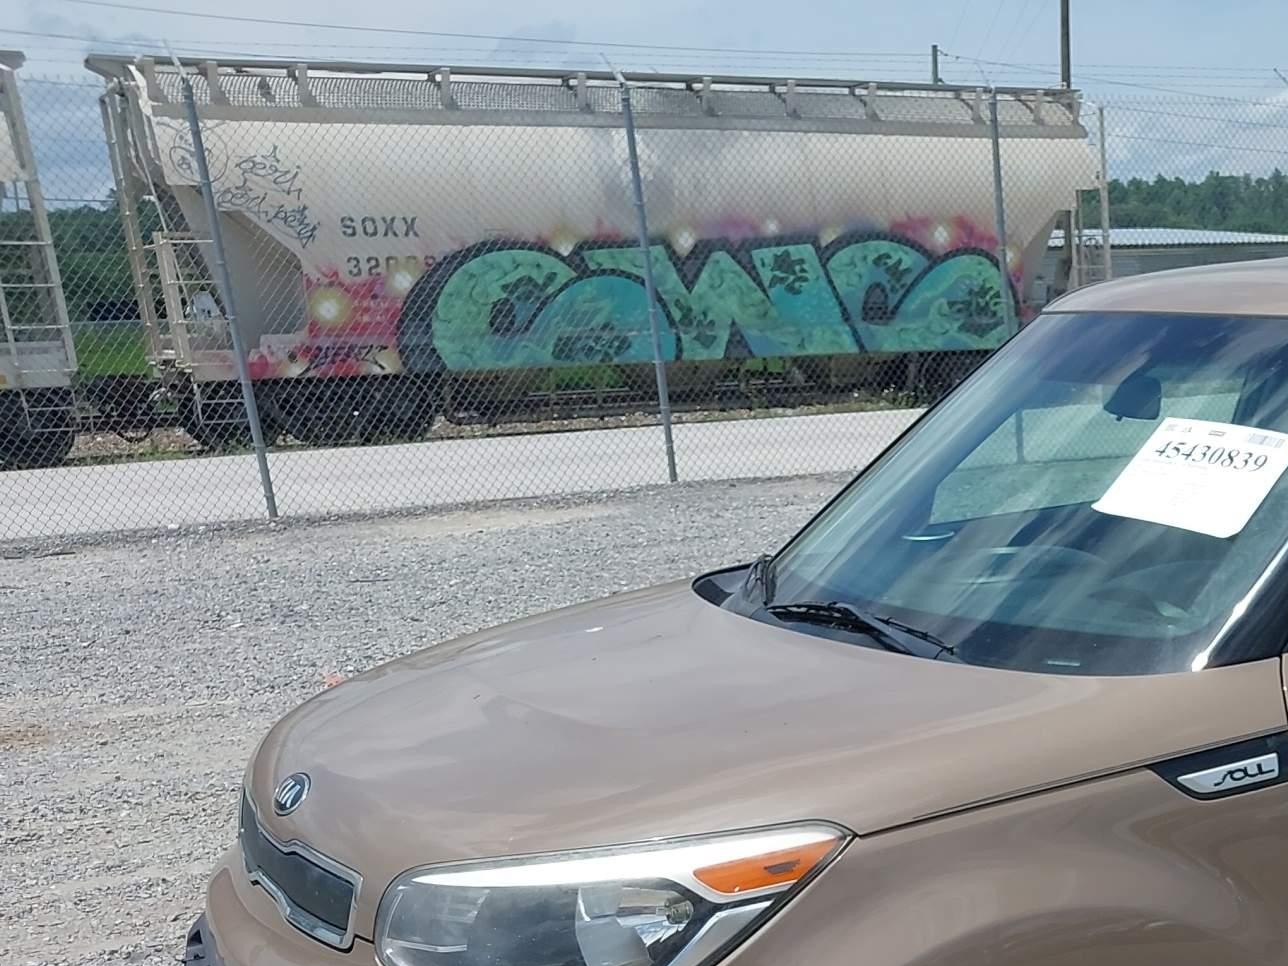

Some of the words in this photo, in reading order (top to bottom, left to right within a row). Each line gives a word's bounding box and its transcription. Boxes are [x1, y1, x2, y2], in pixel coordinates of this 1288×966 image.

[340, 216, 420, 238] SOXX
[1155, 441, 1269, 472] 45430839
[1214, 763, 1276, 787] SOUL
